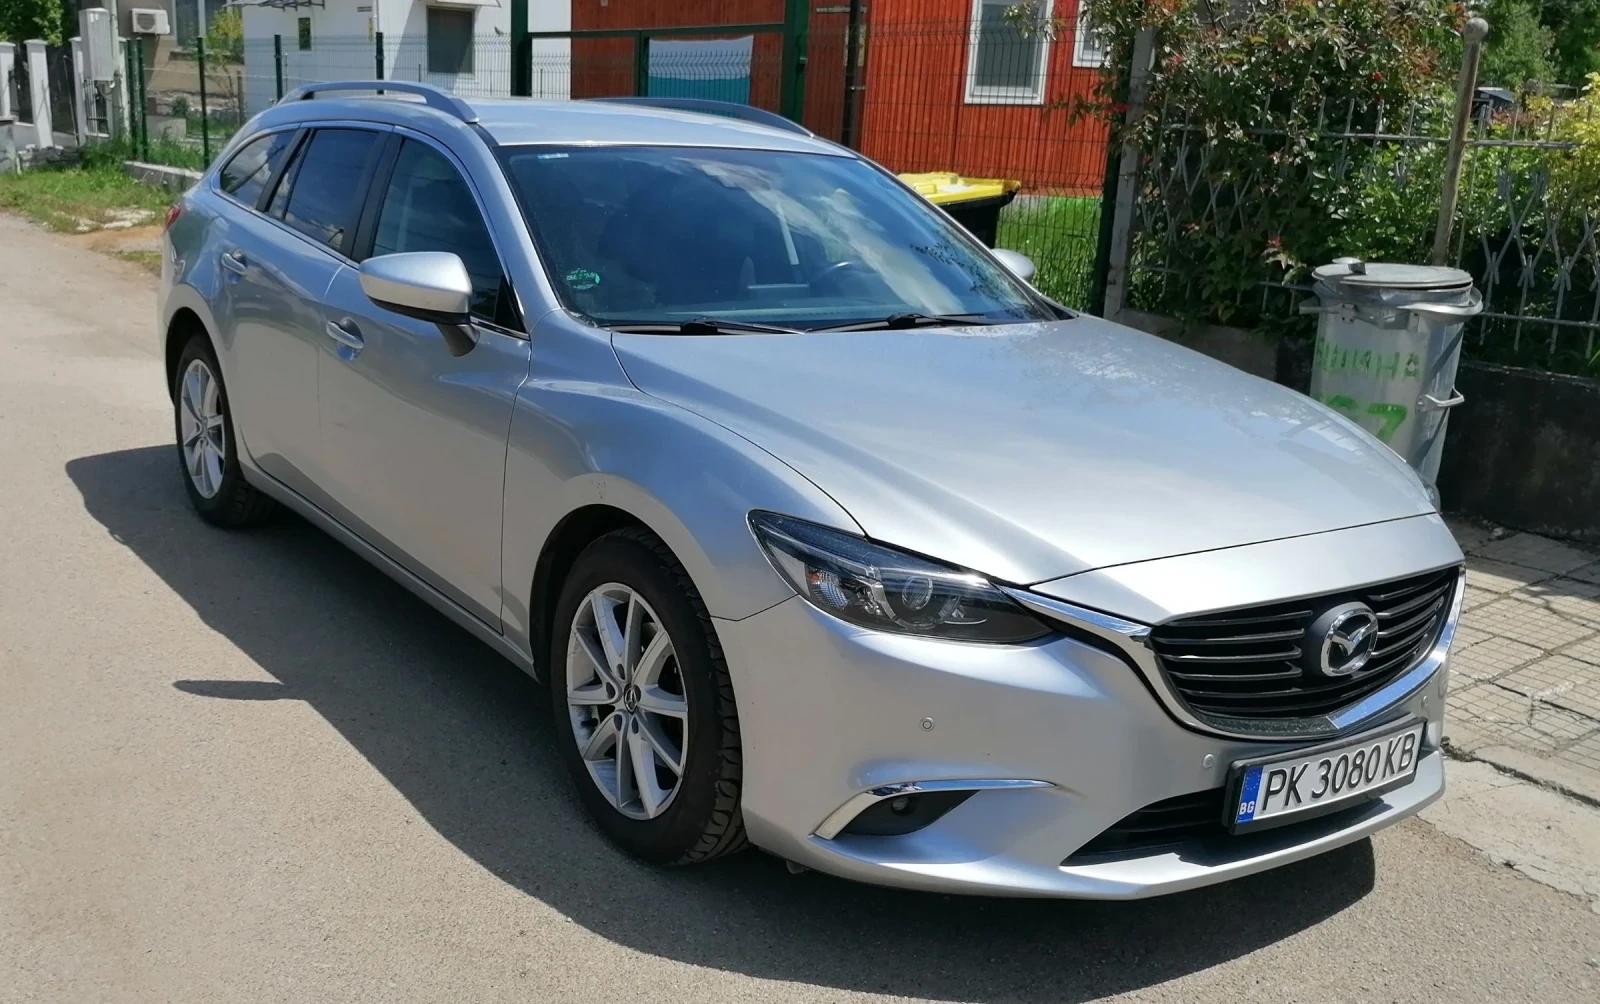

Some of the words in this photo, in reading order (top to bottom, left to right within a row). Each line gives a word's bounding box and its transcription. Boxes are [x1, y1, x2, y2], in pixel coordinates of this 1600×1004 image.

[1262, 763, 1309, 811] PK
[1311, 744, 1381, 800] 3080
[1382, 732, 1416, 779] KB
[1239, 801, 1255, 815] BG
